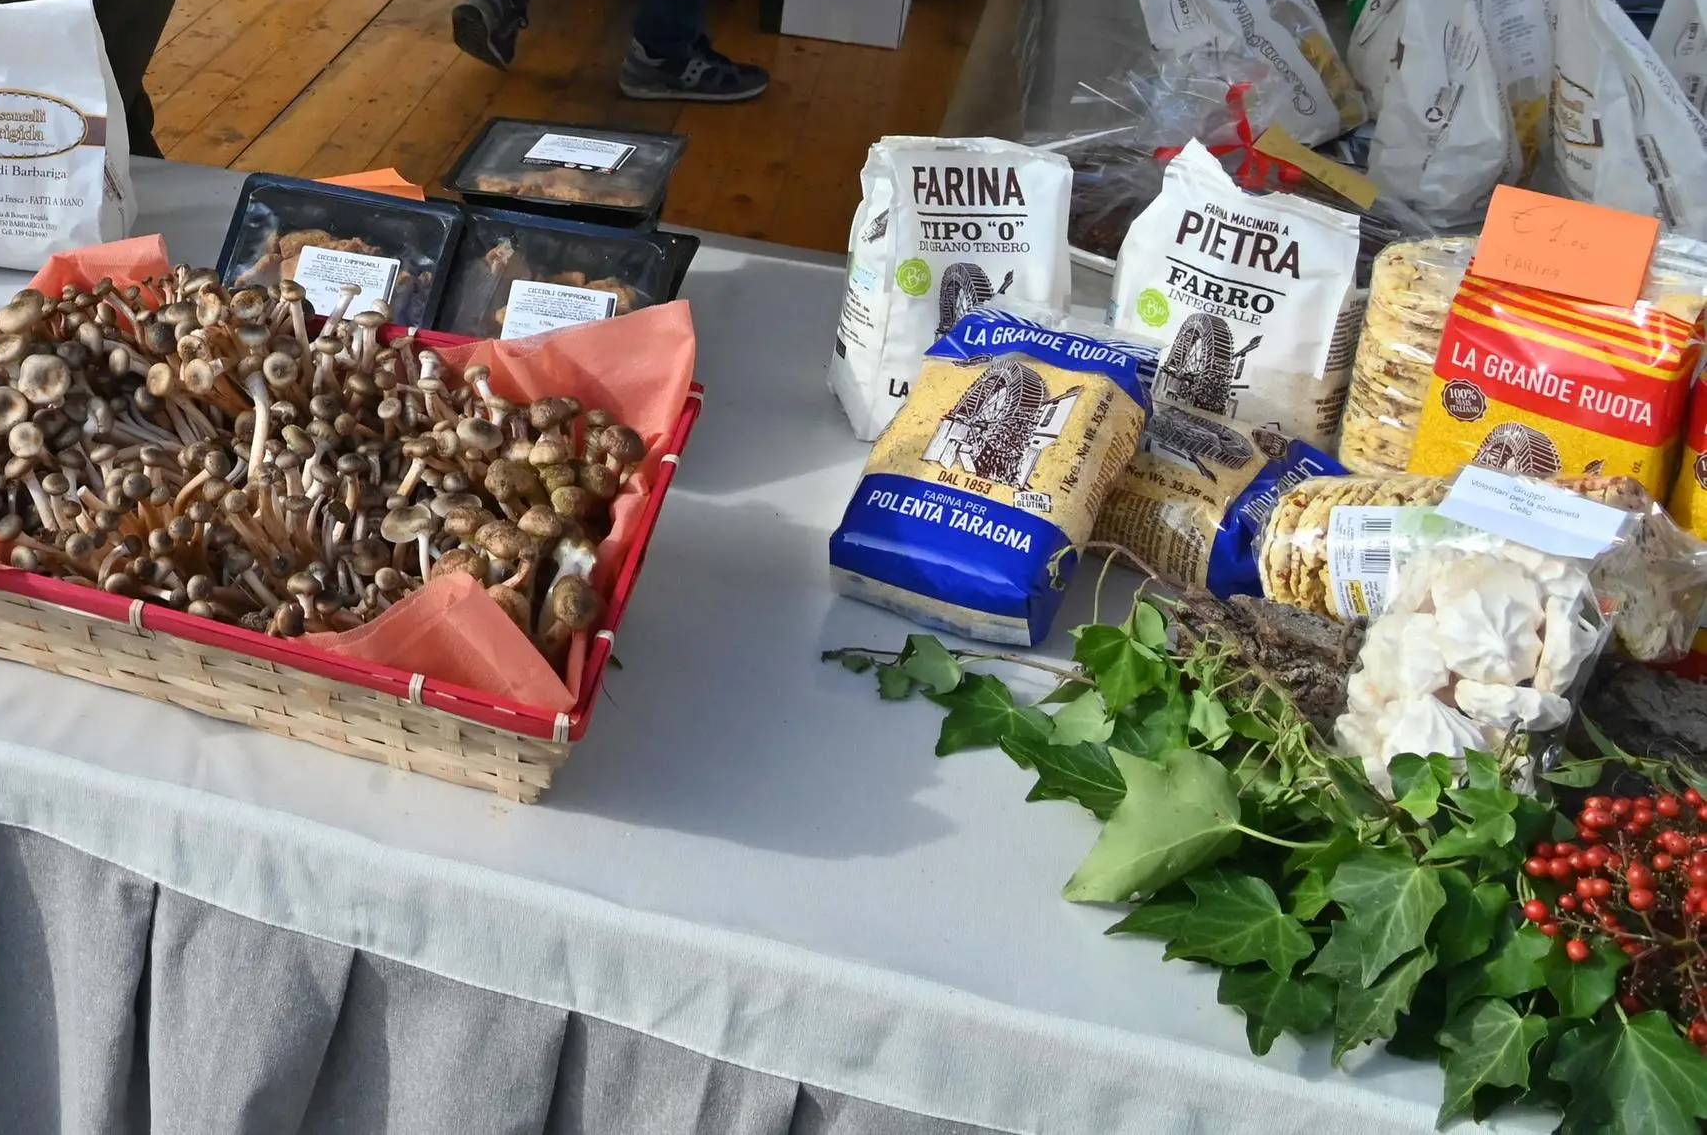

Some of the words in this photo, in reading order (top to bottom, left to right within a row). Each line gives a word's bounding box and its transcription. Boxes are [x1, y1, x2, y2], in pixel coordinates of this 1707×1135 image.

[12, 166, 67, 180] Barbariga
[912, 166, 1026, 207] FARINA
[5, 194, 25, 204] Fresca
[29, 196, 52, 207] FATTI
[53, 198, 59, 206] A
[60, 198, 84, 207] MANO
[9, 220, 45, 230] BARBARIGA
[1230, 214, 1280, 234] MACINATA
[1281, 224, 1289, 236] A
[1511, 205, 1554, 234] €
[2, 228, 13, 236] Cell.
[920, 220, 982, 241] TIPO
[919, 241, 930, 252] DI
[930, 241, 972, 252] GRANO
[973, 242, 1030, 253] TENERO
[1175, 209, 1301, 280] PIETRA
[316, 253, 342, 263] CICCIOLI
[344, 258, 380, 269] CAMPAGNOLI
[904, 267, 928, 289] Bio
[527, 288, 555, 296] CICCIOLI
[557, 291, 596, 302] CAMPAGNOLI
[1165, 265, 1275, 315] FARRO
[1143, 298, 1165, 317] Bio
[1167, 288, 1262, 326] INTEGRALE
[963, 325, 987, 346] LA
[992, 326, 1067, 352] GRANDE
[1067, 340, 1131, 368] RUOTA
[889, 378, 909, 398] LA
[1451, 341, 1477, 372] LA
[1483, 354, 1575, 404] GRANDE
[1578, 384, 1652, 426] RUOTA
[1449, 387, 1477, 401] 100%
[1455, 399, 1471, 408] MAIS
[1091, 401, 1111, 429] 35,28
[1450, 404, 1480, 414] ITALIANO
[937, 470, 959, 486] DAL
[964, 476, 992, 495] 1853
[1168, 482, 1201, 497] 35,28
[1020, 493, 1043, 503] SENZA
[1471, 479, 1509, 498] Volontari
[1509, 493, 1524, 505] per
[1526, 499, 1535, 507] la
[1536, 501, 1581, 520] solidarietà
[1513, 484, 1547, 502] Gruppo
[922, 490, 963, 508] FARINA
[965, 501, 989, 516] PER
[1016, 500, 1049, 512] GLUTINE
[1509, 502, 1533, 516] Dello
[867, 490, 945, 524] POLENTA
[947, 509, 1033, 554] TARAGNA
